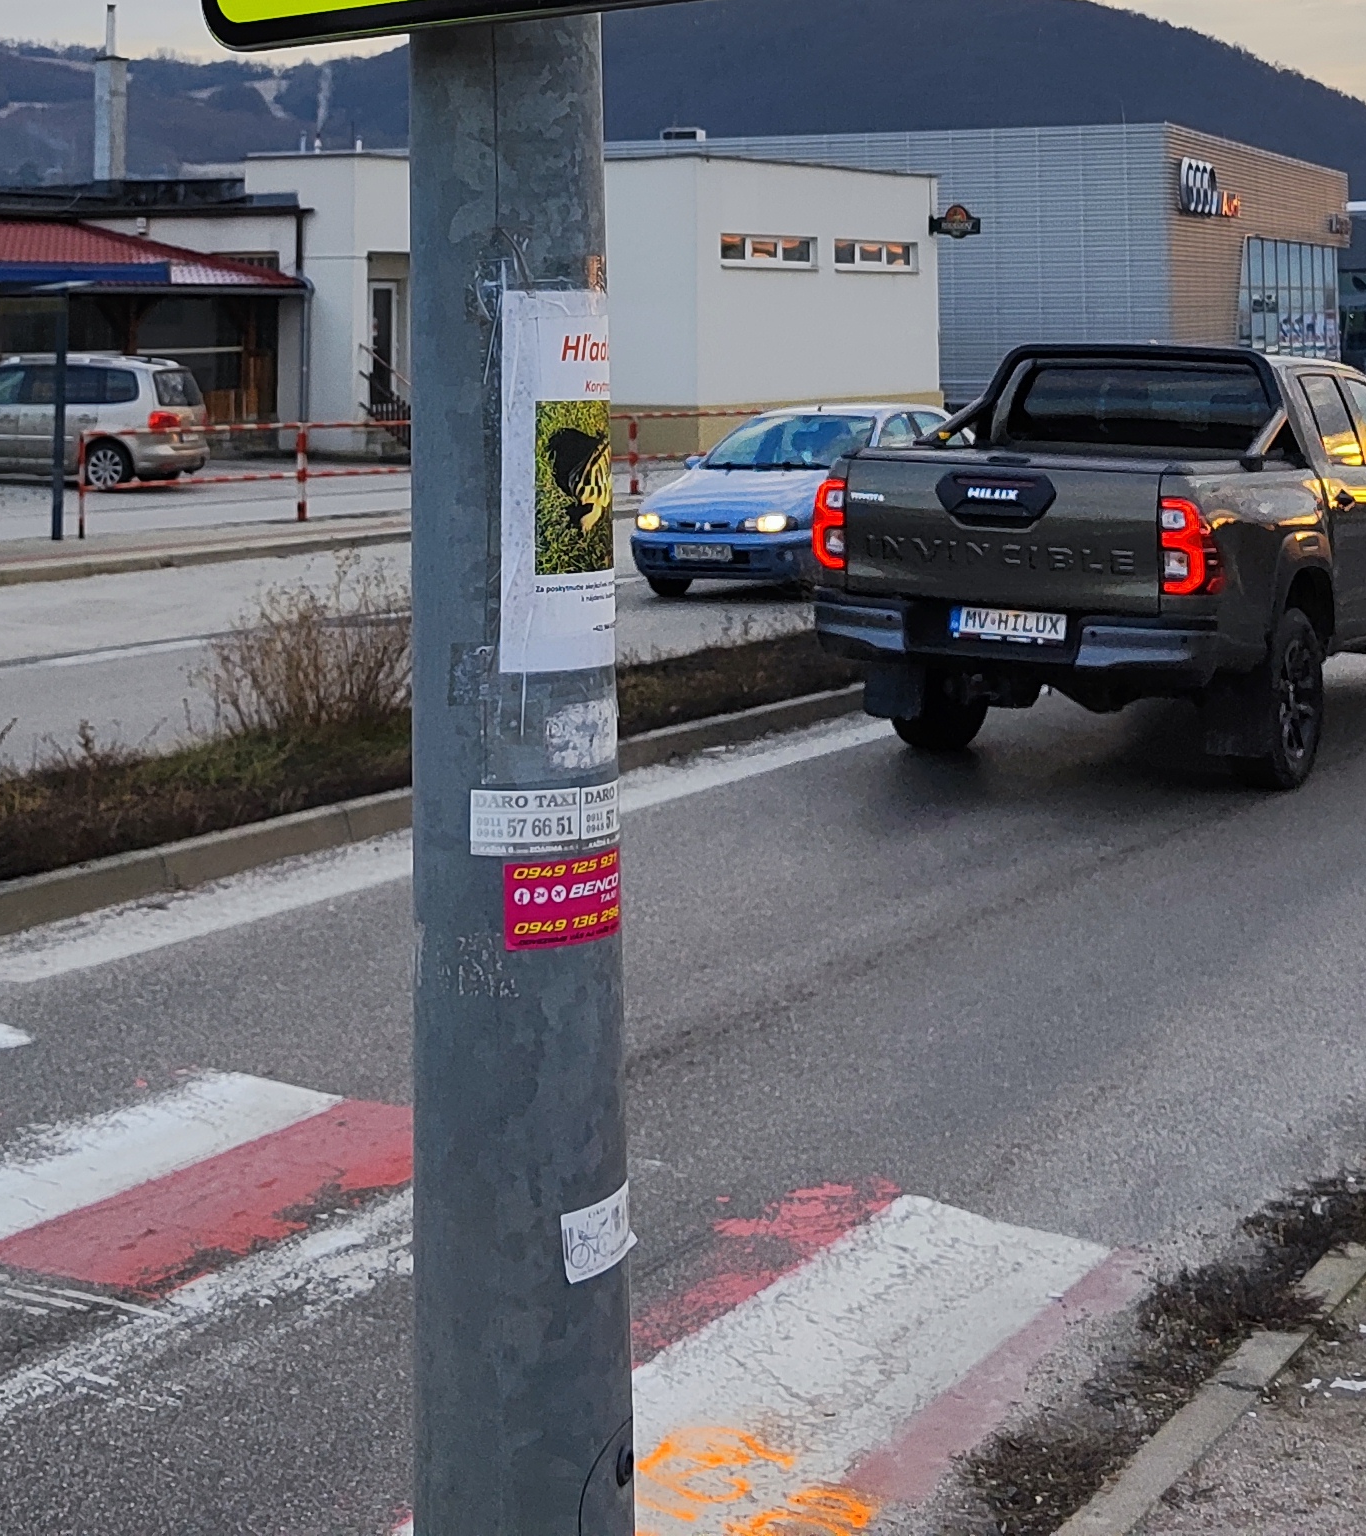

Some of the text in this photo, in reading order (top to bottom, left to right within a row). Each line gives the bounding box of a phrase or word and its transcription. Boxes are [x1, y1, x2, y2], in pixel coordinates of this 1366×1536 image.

[561, 333, 609, 361] Hľad
[967, 487, 1020, 501] HILUX
[866, 533, 1135, 576] INVINCIBLE
[474, 793, 577, 809] DARO TAXI
[584, 786, 615, 805] DARO
[476, 817, 501, 827] 0911
[506, 815, 574, 838] 57 66 51
[513, 851, 618, 880] 0949 125 931
[568, 872, 619, 899] BENCO
[600, 890, 617, 903] TAXI
[513, 919, 568, 935] 0949
[571, 913, 598, 929] 136
